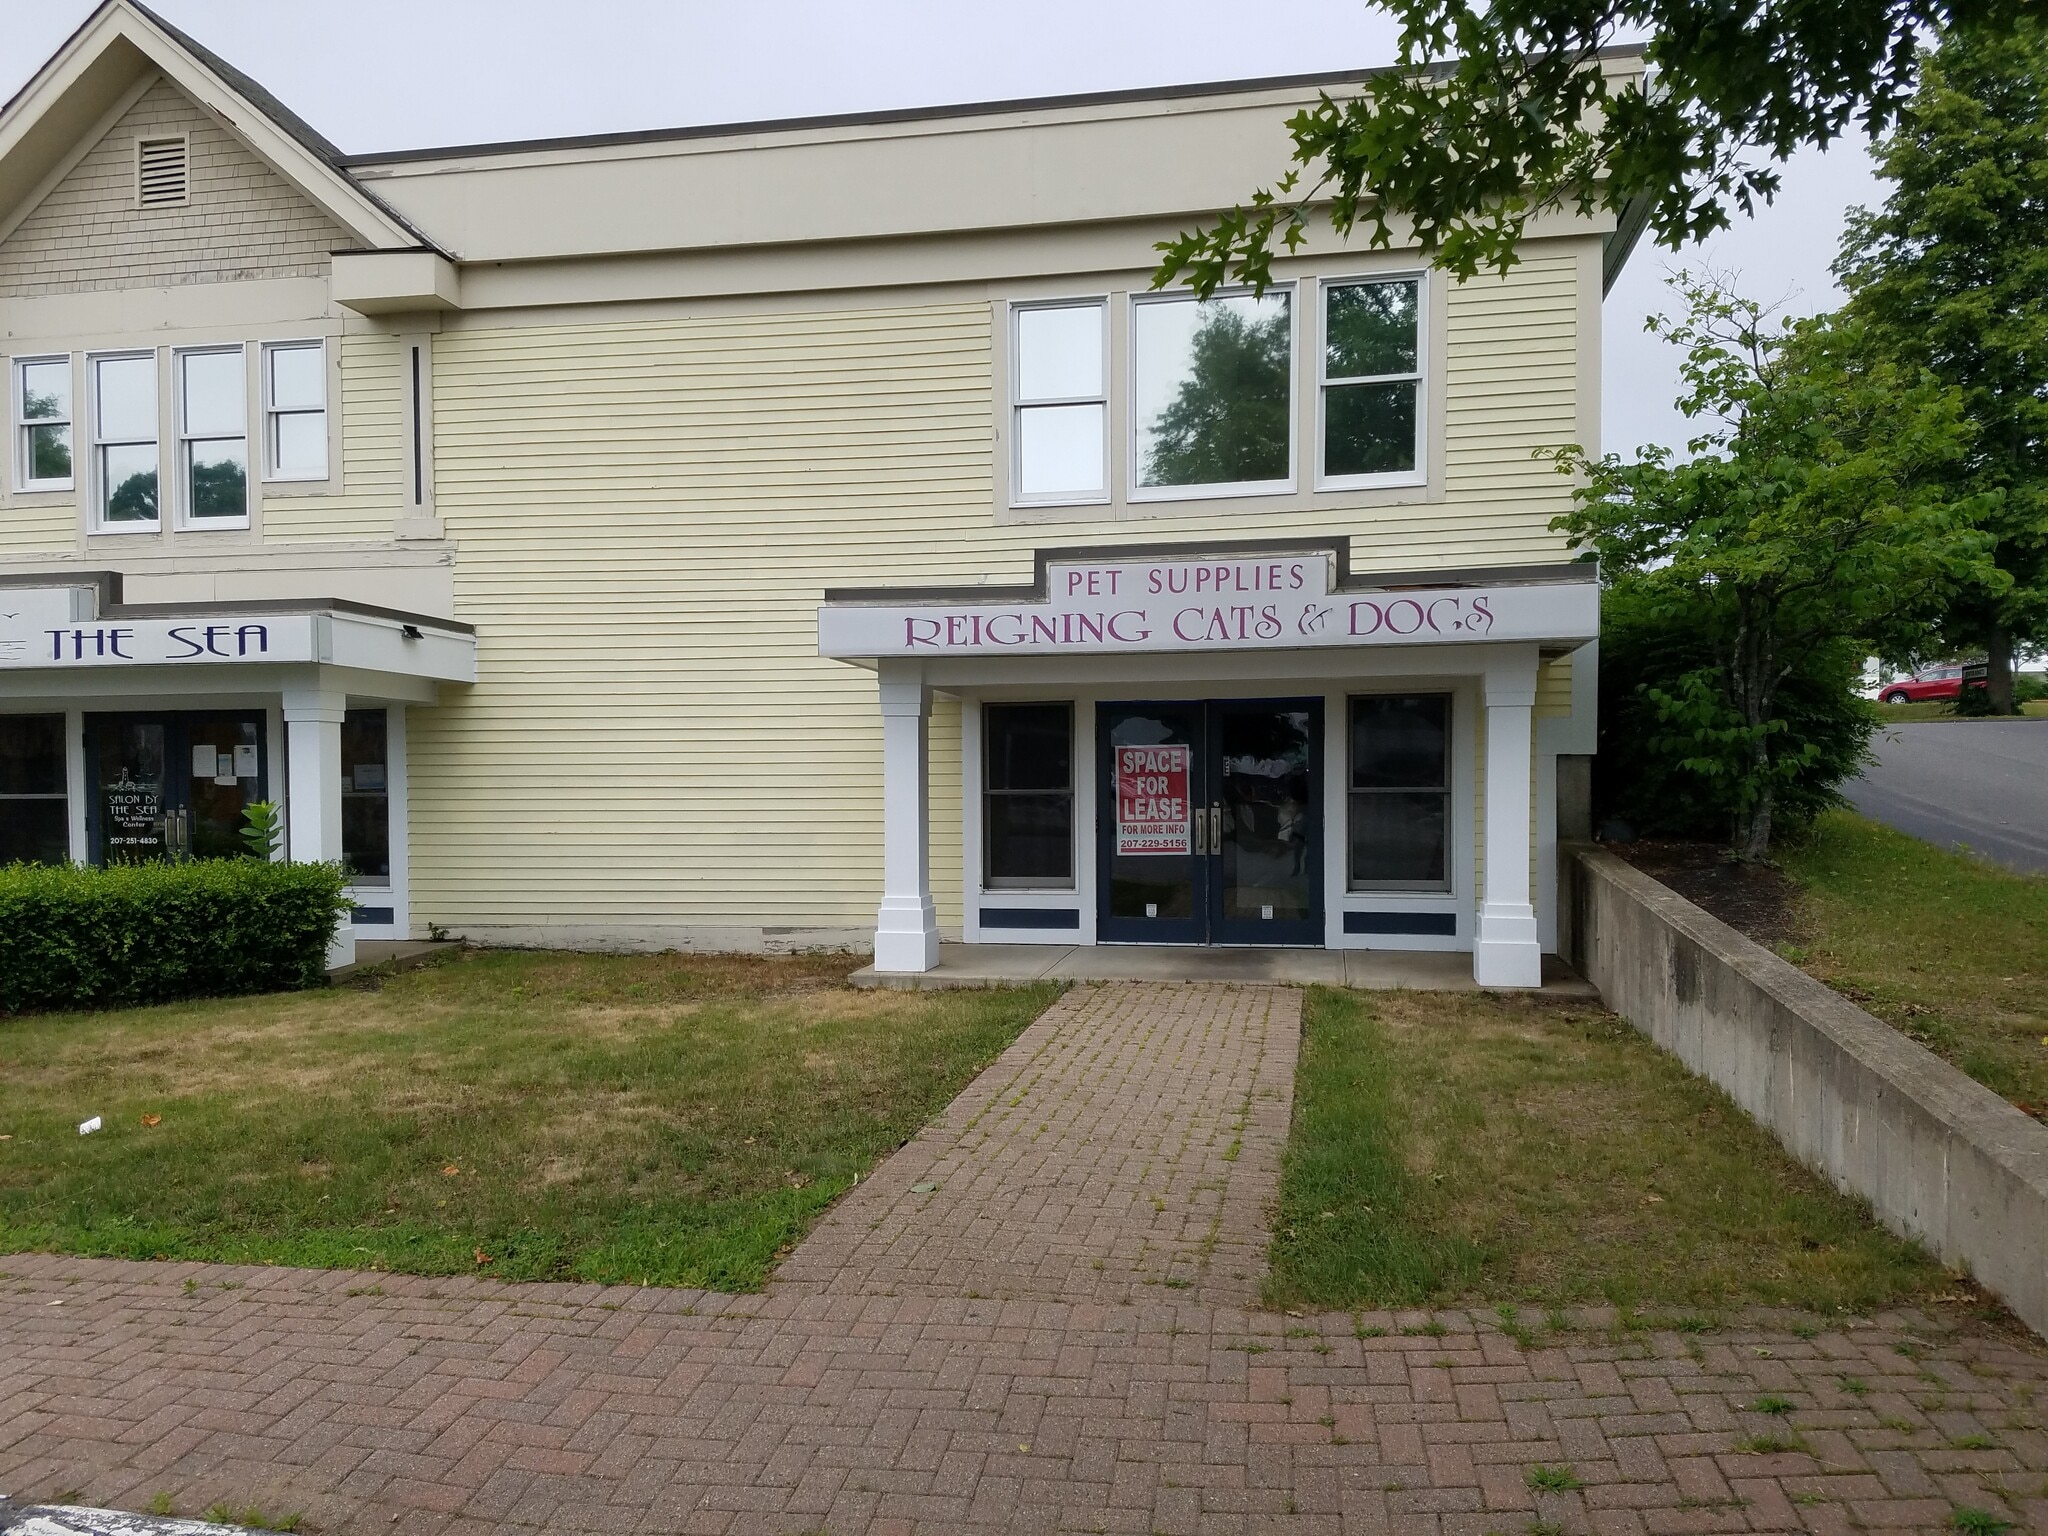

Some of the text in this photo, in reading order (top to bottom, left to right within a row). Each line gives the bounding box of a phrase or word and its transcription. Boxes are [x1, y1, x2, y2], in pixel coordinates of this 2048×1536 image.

[1067, 563, 1304, 597] PET SUPPLIES
[904, 596, 1495, 650] REIGNING CATS & DOGS
[44, 624, 268, 661] THE SEA
[1122, 750, 1182, 774] SPACE
[1136, 776, 1169, 795] FOR
[108, 795, 159, 805] SALON BY
[109, 805, 157, 815] THE SEA
[1124, 797, 1183, 821] LEASE
[114, 815, 124, 823] Spa
[1122, 824, 1185, 835] FOR MORE INFO
[110, 837, 158, 845] 207-251-4830
[1120, 839, 1187, 848] 207-229-5156
